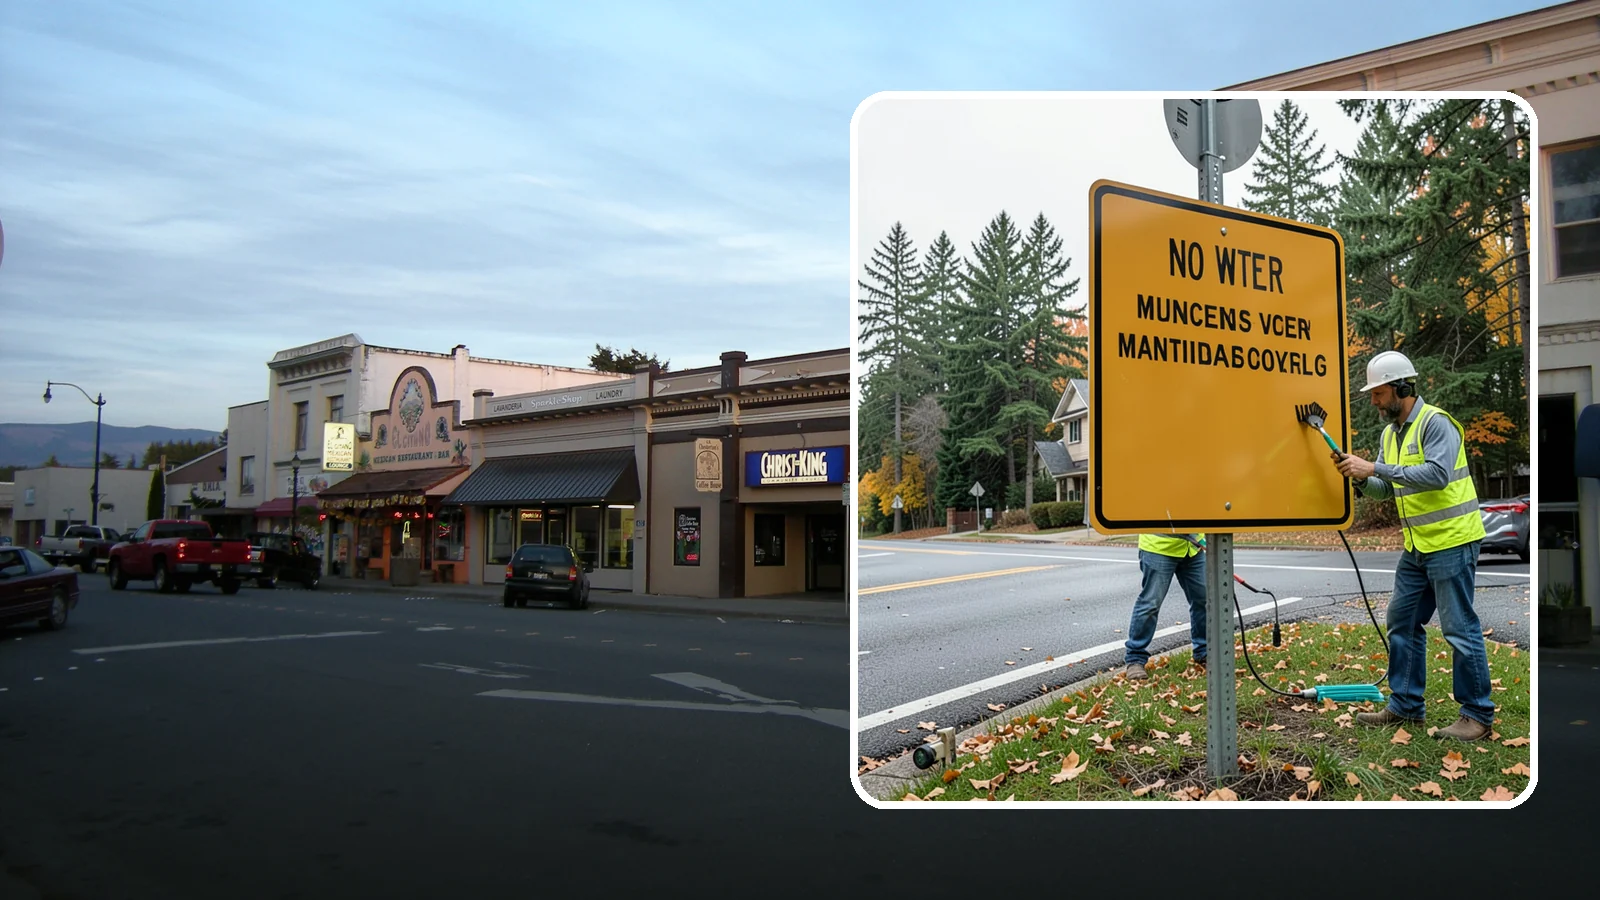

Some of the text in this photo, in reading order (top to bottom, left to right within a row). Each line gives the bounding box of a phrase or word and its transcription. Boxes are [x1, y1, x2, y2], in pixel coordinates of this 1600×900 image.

[1169, 238, 1284, 294] NO WTER
[1137, 294, 1252, 332] MUNCENS
[493, 389, 623, 413] LAVANDERIA Sparkle Shop LAUNDRY
[373, 450, 450, 464] MEXICAN RESTAURANT BAR
[761, 450, 827, 478] CHRIST KING
